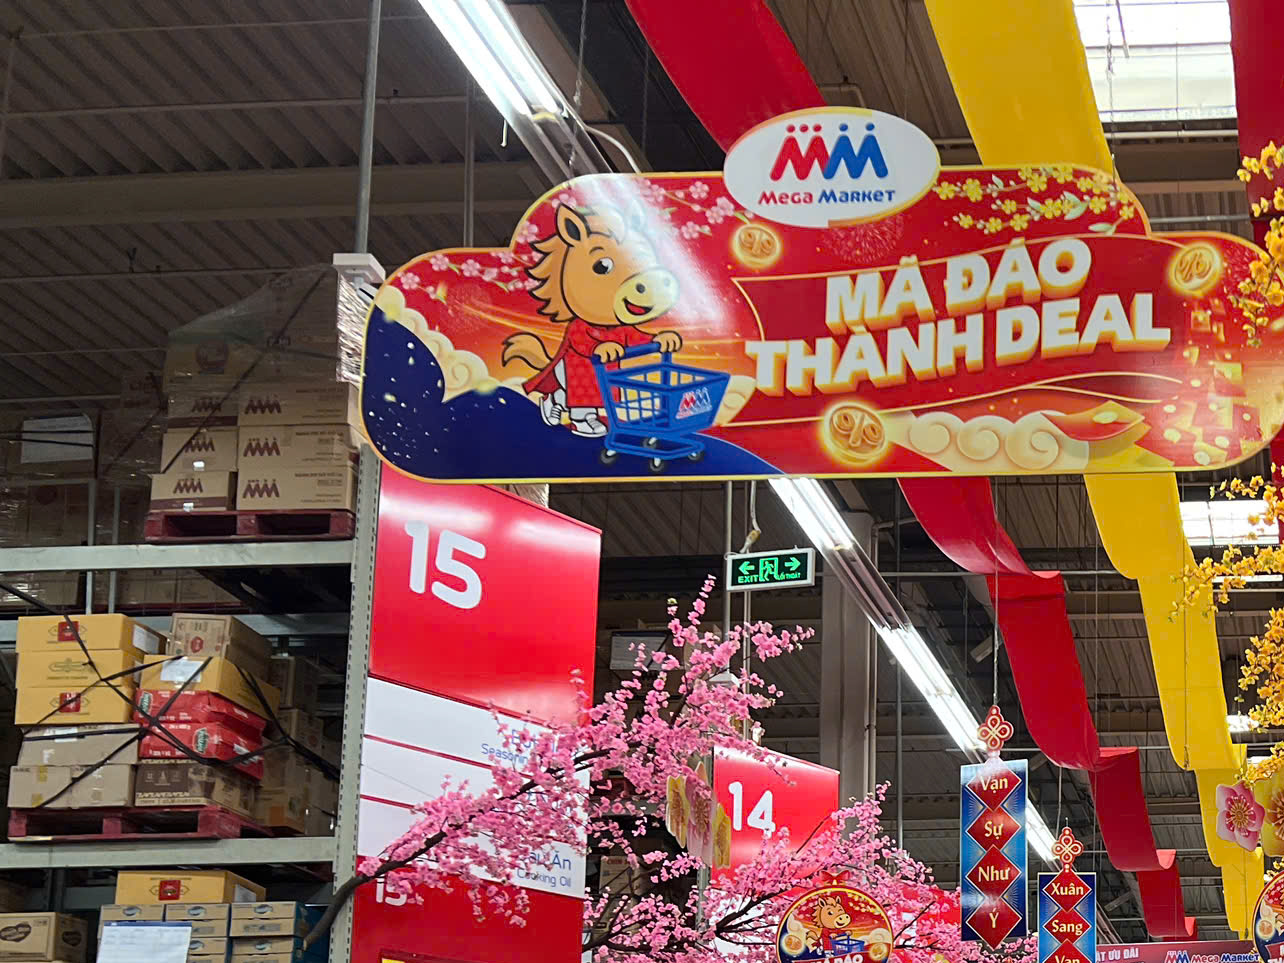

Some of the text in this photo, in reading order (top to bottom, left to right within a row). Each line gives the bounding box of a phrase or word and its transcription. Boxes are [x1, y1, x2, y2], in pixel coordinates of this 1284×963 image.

[746, 292, 1172, 396] THÀNH DEAL
[404, 520, 487, 610] 15
[737, 575, 759, 583] EXIT
[980, 776, 1009, 793] Vạn
[727, 781, 776, 838] 14
[559, 876, 572, 888] Oil
[978, 866, 1011, 883] Như
[1050, 881, 1084, 898] Xuân
[1051, 919, 1083, 935] Sang
